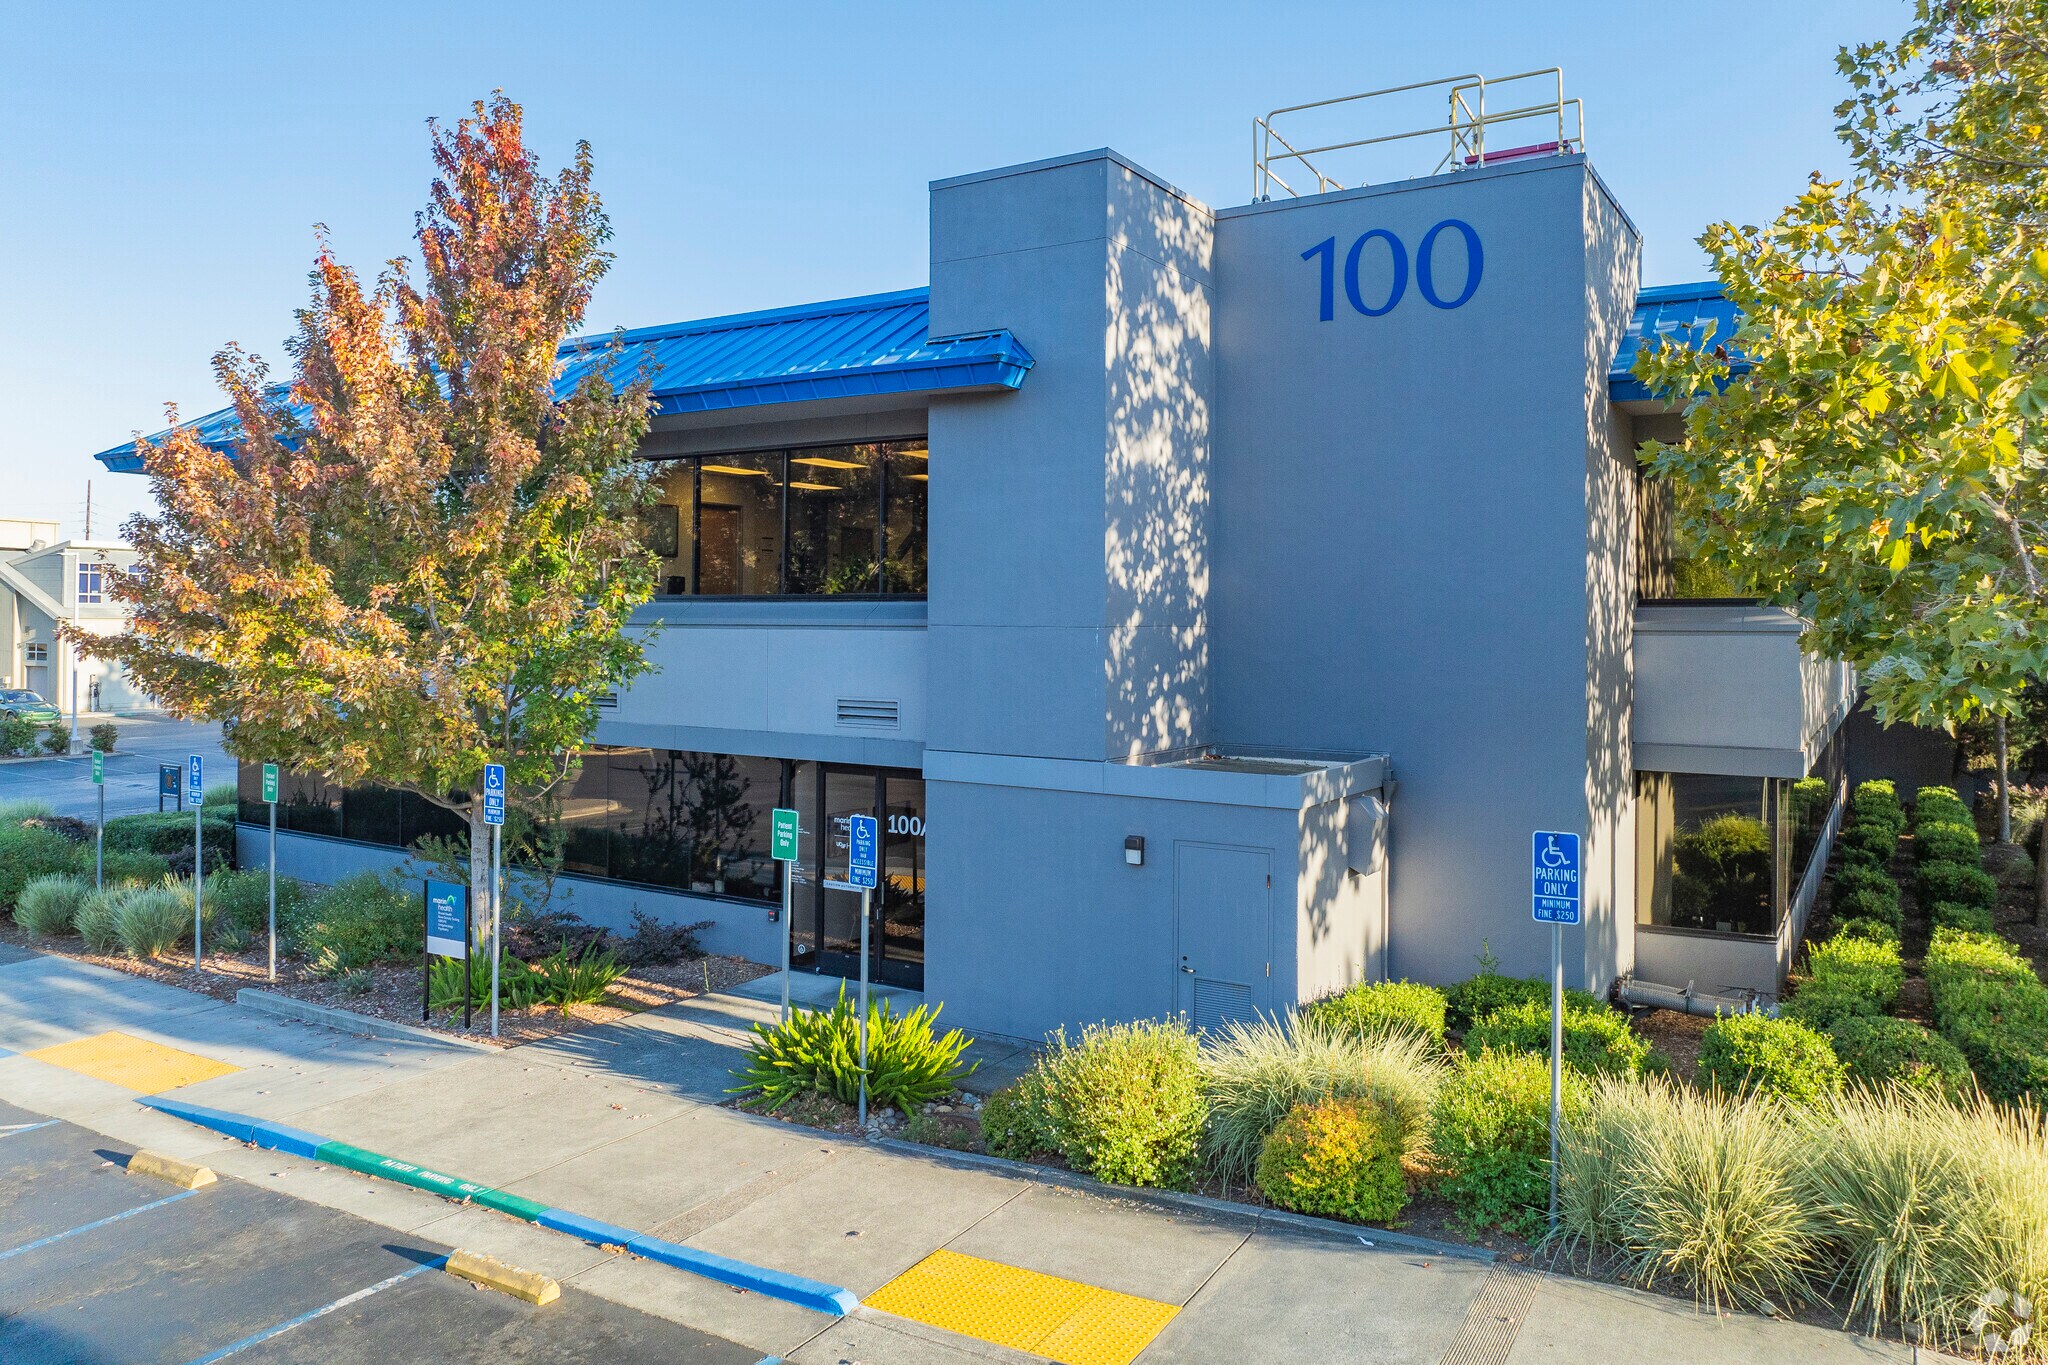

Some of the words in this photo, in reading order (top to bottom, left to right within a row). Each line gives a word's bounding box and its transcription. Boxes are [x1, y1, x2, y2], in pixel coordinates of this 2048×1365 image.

[1301, 219, 1484, 321] 100
[777, 830, 793, 839] Parking
[780, 839, 789, 847] Only
[855, 839, 871, 847] PARKING
[855, 868, 871, 876] MINIMUM
[1535, 867, 1577, 882] PARKING
[851, 876, 861, 884] FINE
[862, 877, 874, 885] $250
[1543, 881, 1568, 896] ONLY
[438, 904, 452, 912] health
[1541, 899, 1571, 909] MINIMUM
[1538, 909, 1552, 919] FINE
[1556, 910, 1575, 920] $250
[380, 1159, 418, 1173] PATIENT
